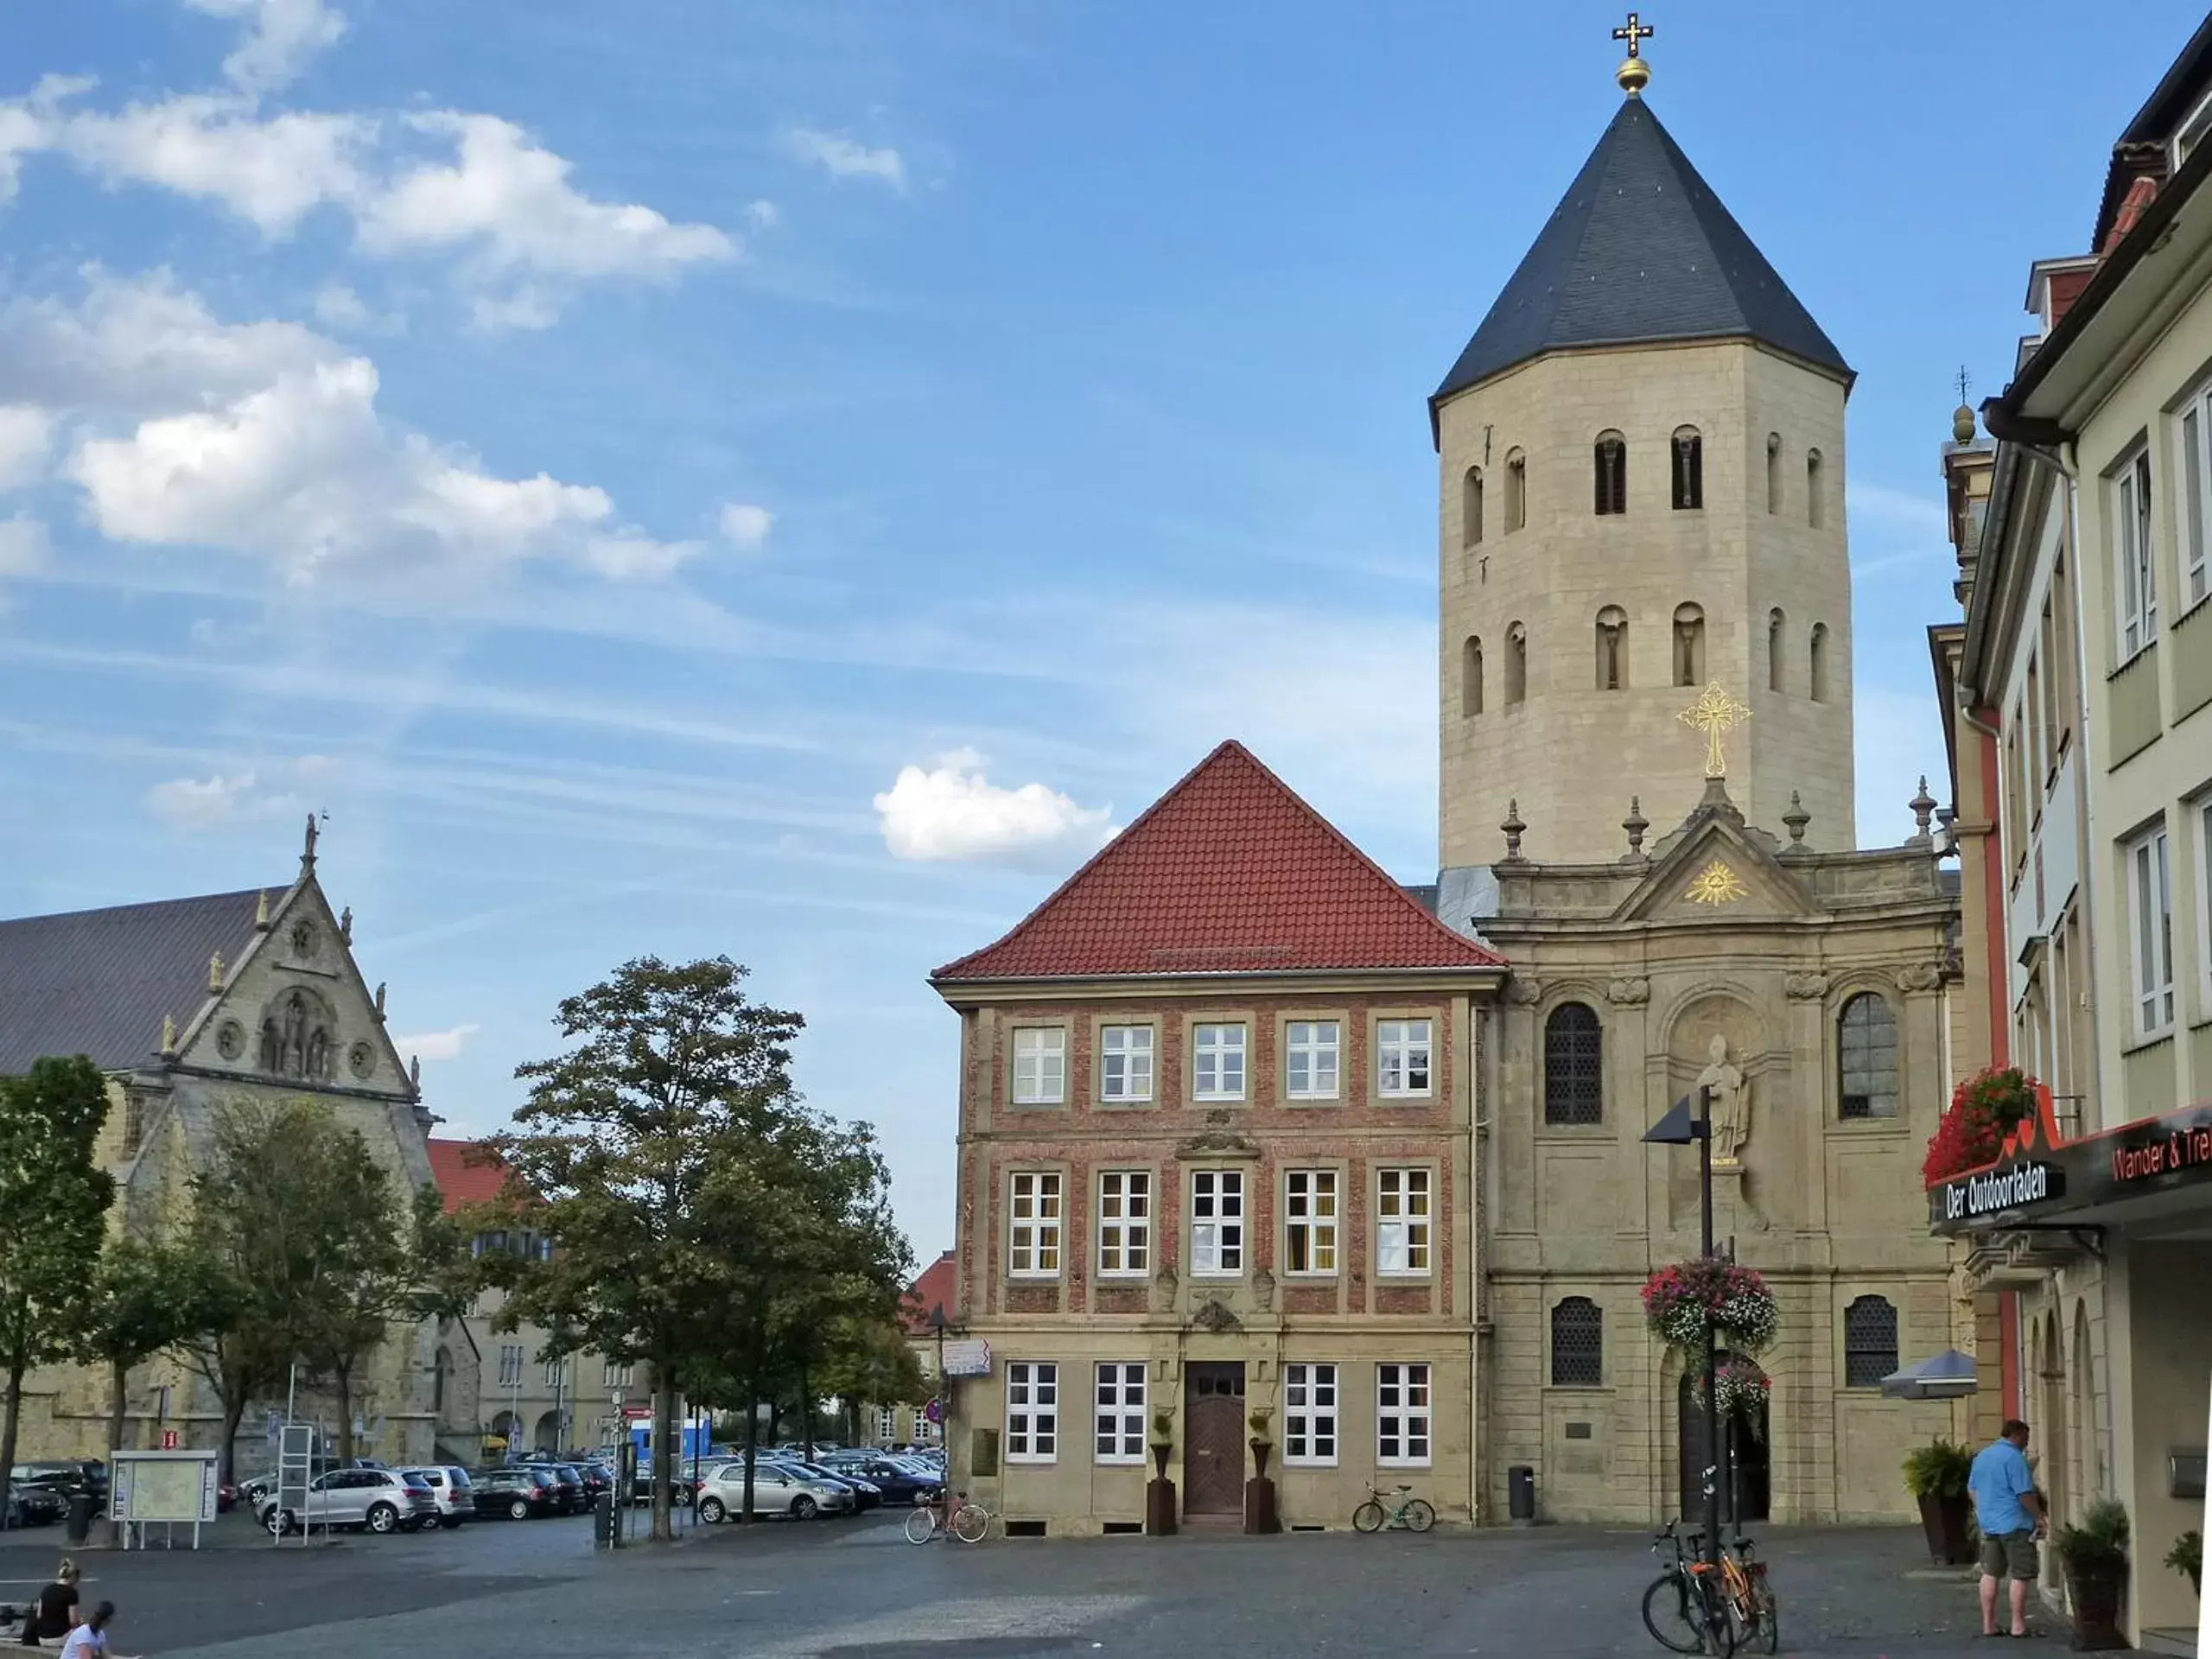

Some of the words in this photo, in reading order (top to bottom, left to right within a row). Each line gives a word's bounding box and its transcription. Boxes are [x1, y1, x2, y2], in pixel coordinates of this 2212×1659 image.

[2112, 1138, 2165, 1182] Wander
[2170, 1131, 2180, 1169] &
[1947, 1183, 1966, 1219] Der
[1969, 1160, 2046, 1214] Outdoorladen
